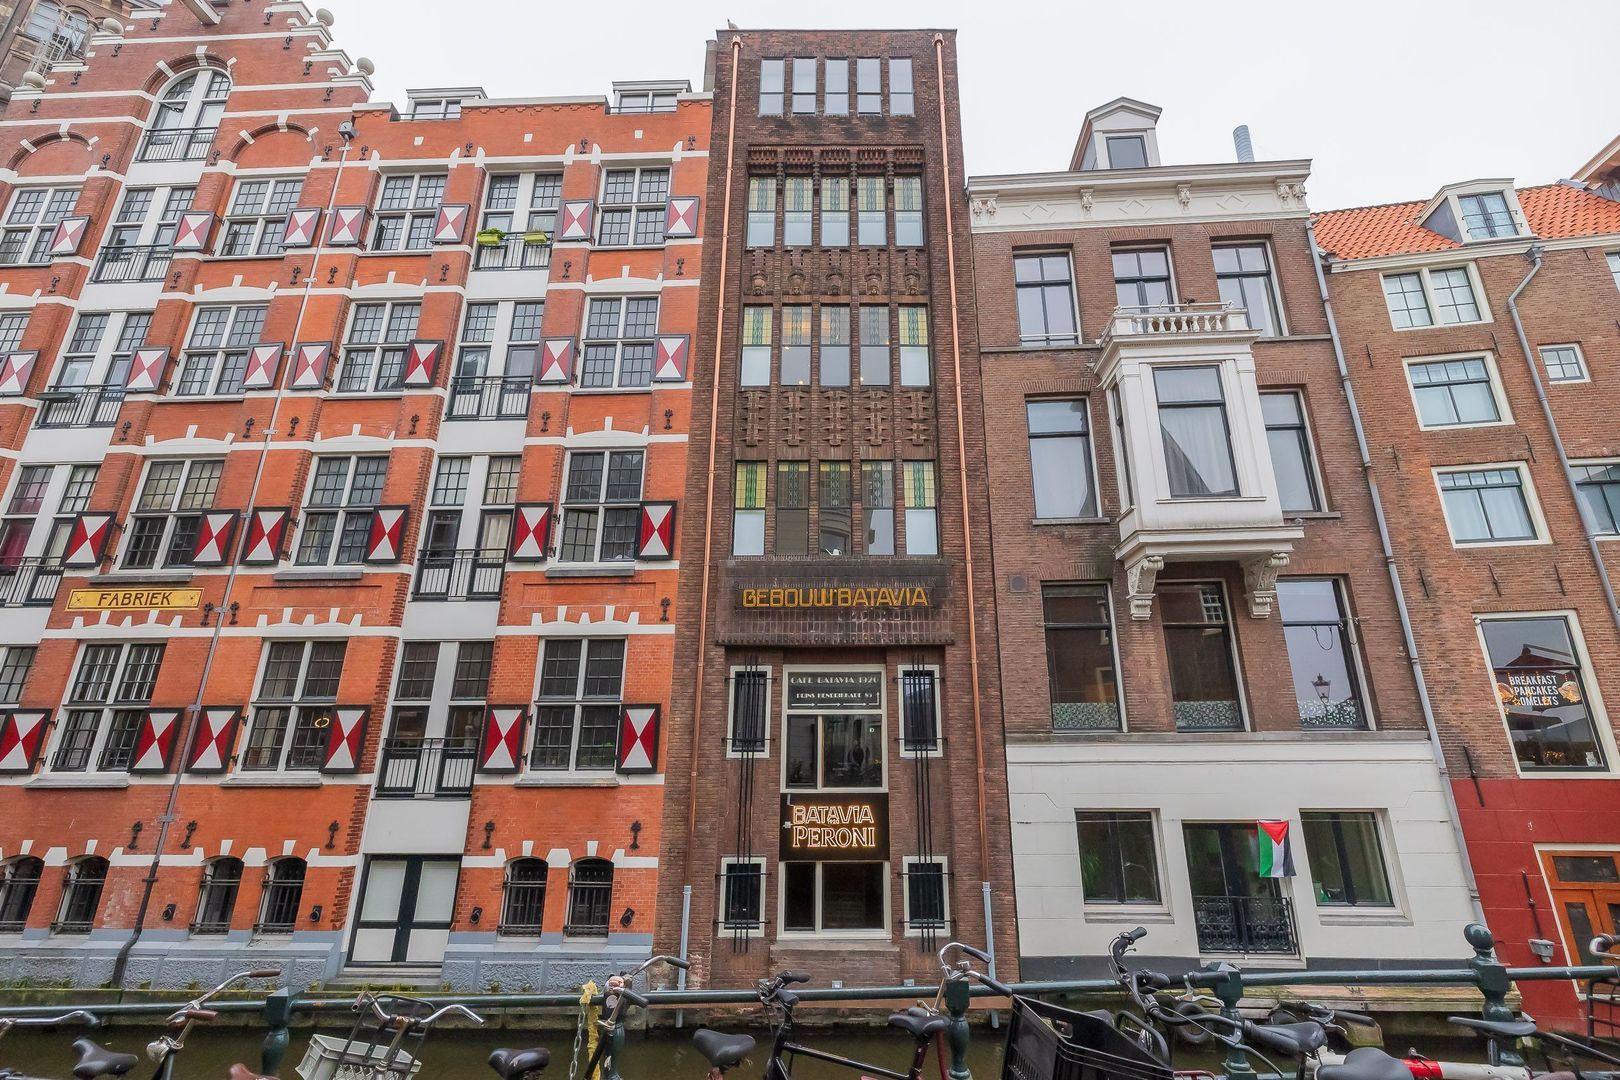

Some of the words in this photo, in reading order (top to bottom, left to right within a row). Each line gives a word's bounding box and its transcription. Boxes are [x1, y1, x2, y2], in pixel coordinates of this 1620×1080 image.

[98, 592, 172, 606] FABRIEK
[743, 588, 833, 607] GEBOUW
[837, 588, 928, 607] BATAVIA
[817, 676, 855, 684] BATAVIA
[1508, 675, 1558, 686] BREAKFAST
[1513, 685, 1559, 696] PANCAKES
[1519, 696, 1559, 706] OMELETS
[793, 805, 875, 825] BATAVIA
[792, 825, 876, 848] PERONI
